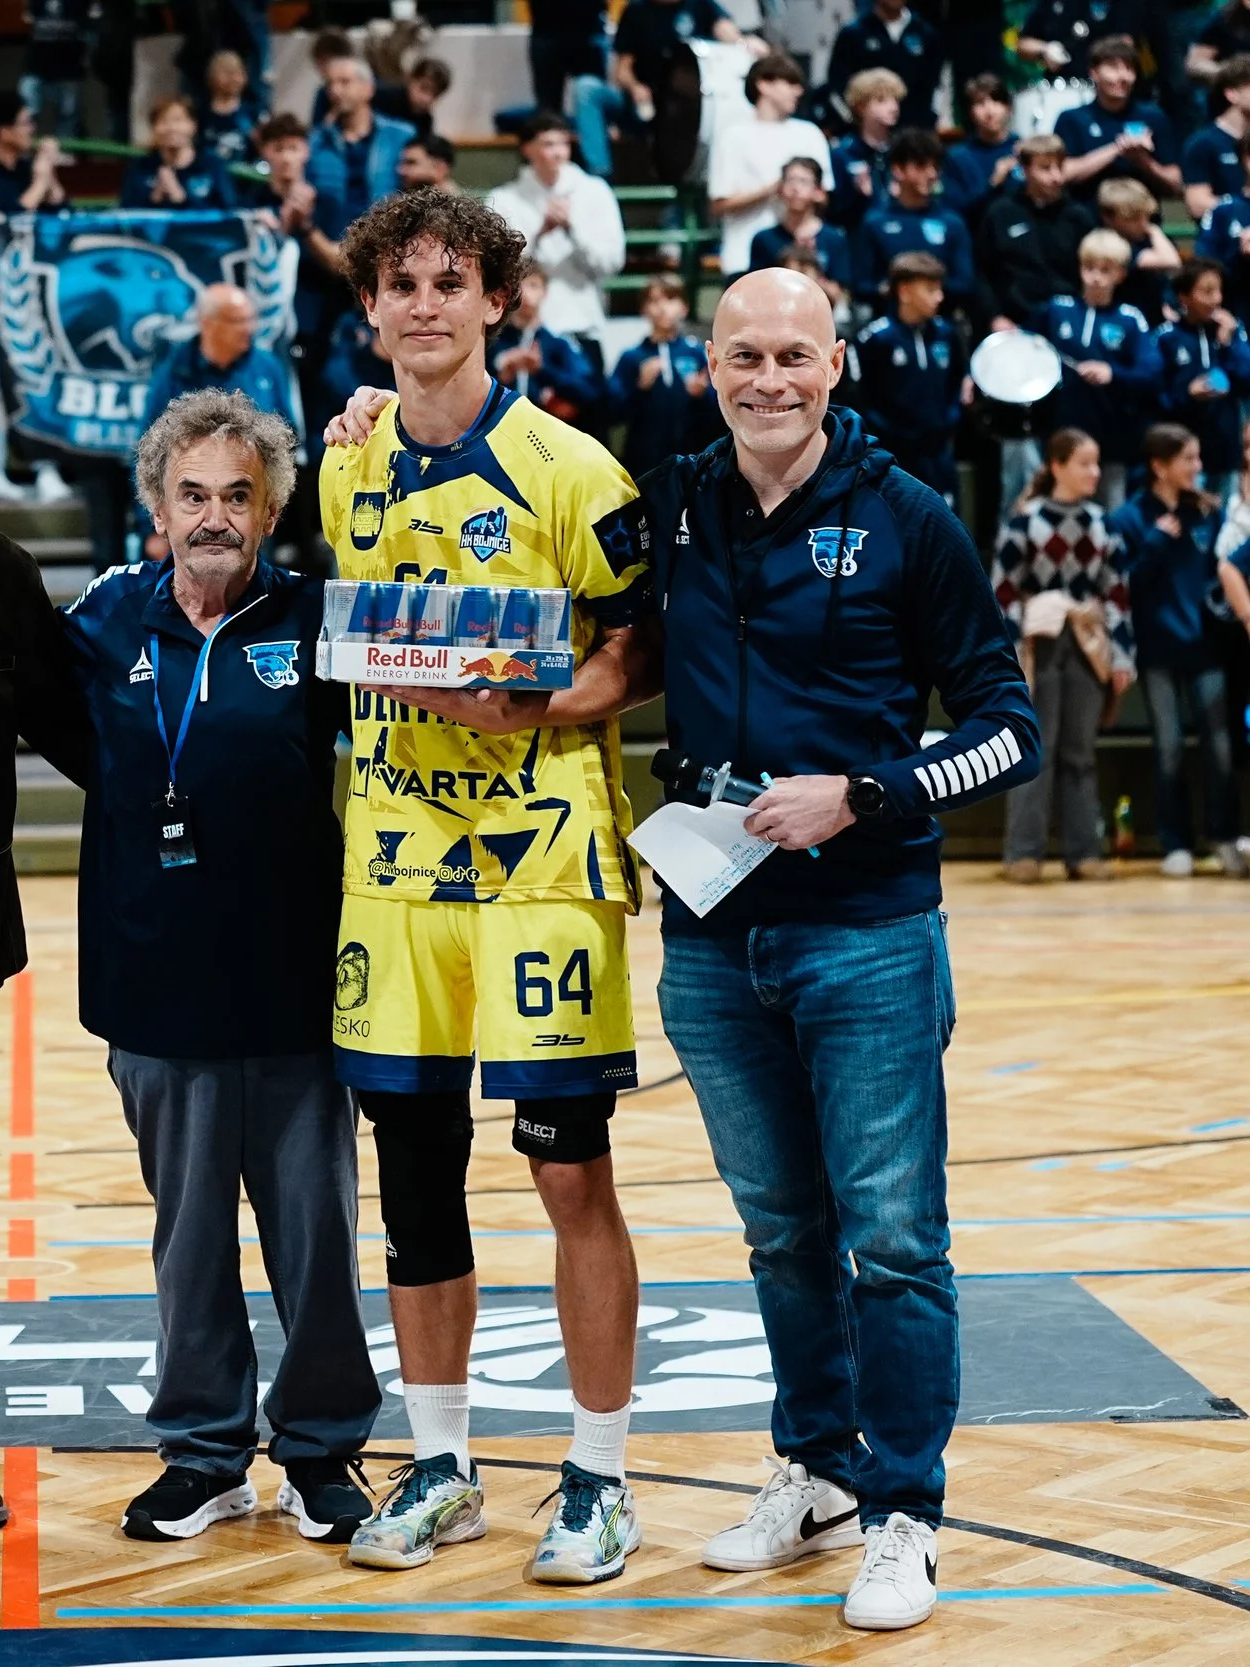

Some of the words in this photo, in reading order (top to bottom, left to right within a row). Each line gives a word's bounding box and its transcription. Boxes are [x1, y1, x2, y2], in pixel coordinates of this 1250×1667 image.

[473, 534, 510, 553] BOJNICE
[421, 620, 441, 631] Bull
[367, 647, 407, 668] Red
[410, 649, 448, 669] Bull
[129, 671, 155, 685] SELECT
[366, 669, 410, 680] ENERGY
[413, 670, 447, 681] DRINK
[377, 766, 520, 800] VARTA
[162, 822, 185, 839] STAFF
[514, 948, 593, 1018] 64
[518, 1117, 557, 1140] SELECT
